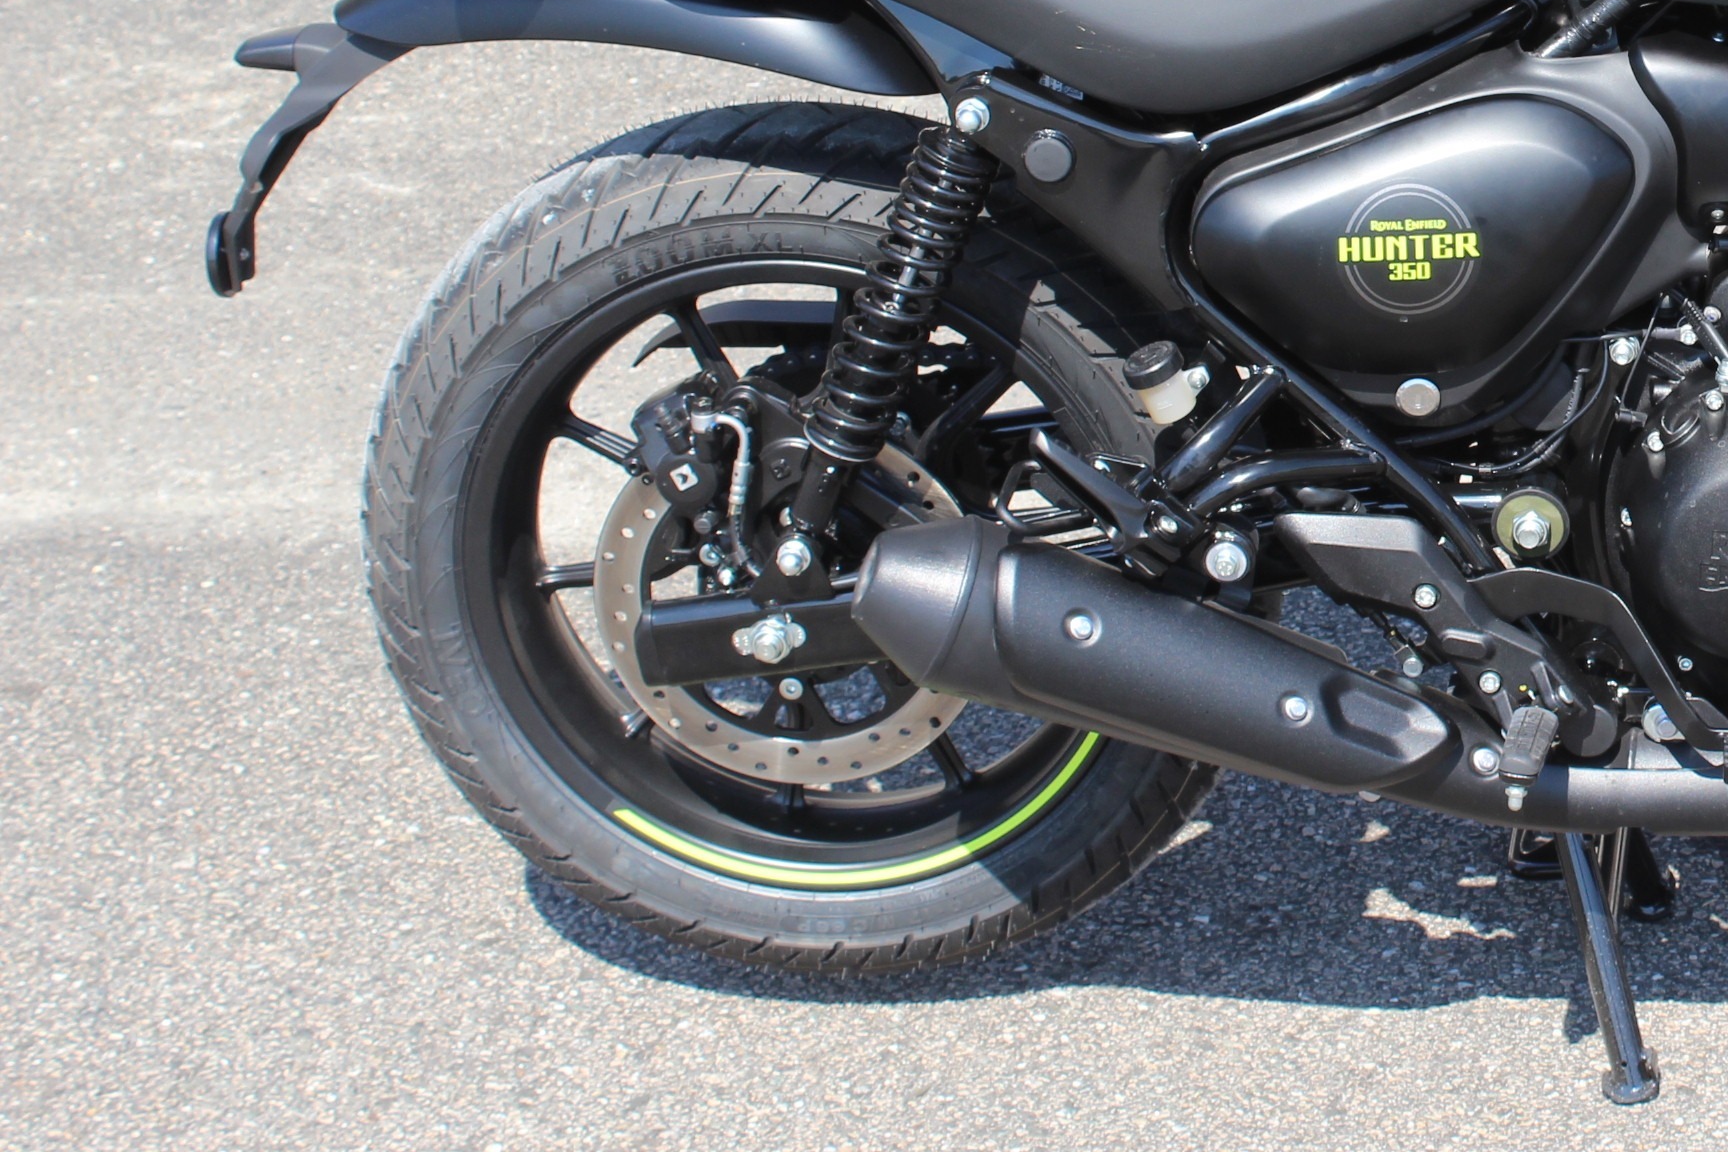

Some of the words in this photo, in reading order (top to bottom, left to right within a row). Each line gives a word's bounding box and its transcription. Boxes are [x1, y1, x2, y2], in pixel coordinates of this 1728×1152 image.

[1370, 219, 1404, 232] ROYAL
[1404, 218, 1447, 232] ENFIELD
[1337, 231, 1481, 263] HUNTER
[1388, 261, 1432, 281] 350
